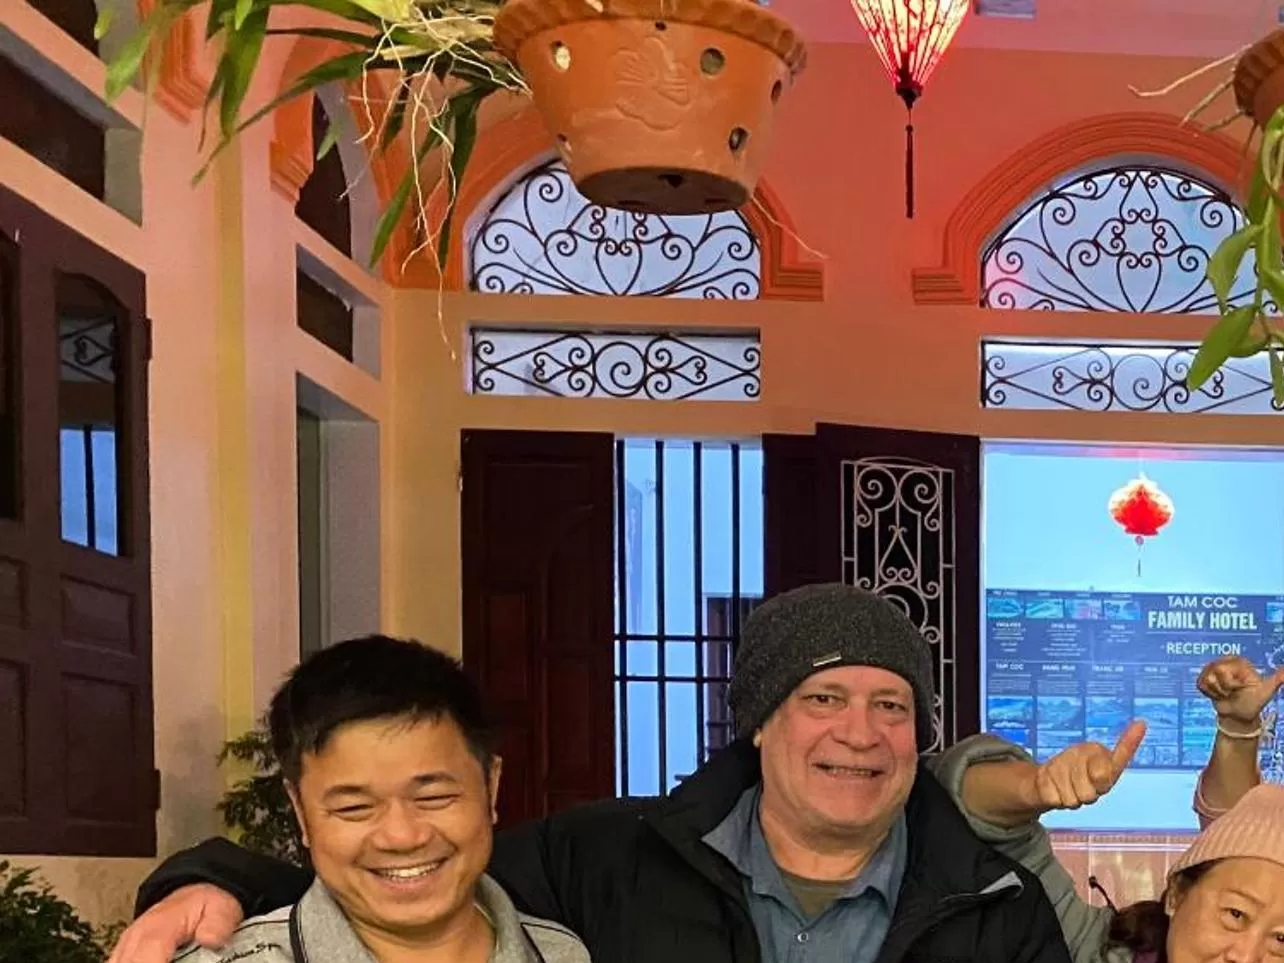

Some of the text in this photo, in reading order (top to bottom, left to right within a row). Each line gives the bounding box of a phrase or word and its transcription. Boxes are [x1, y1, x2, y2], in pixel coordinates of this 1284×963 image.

[1167, 595, 1238, 608] TAM COC
[1148, 611, 1257, 630] FAMILY HOTEL
[1166, 642, 1241, 655] RECEPTION
